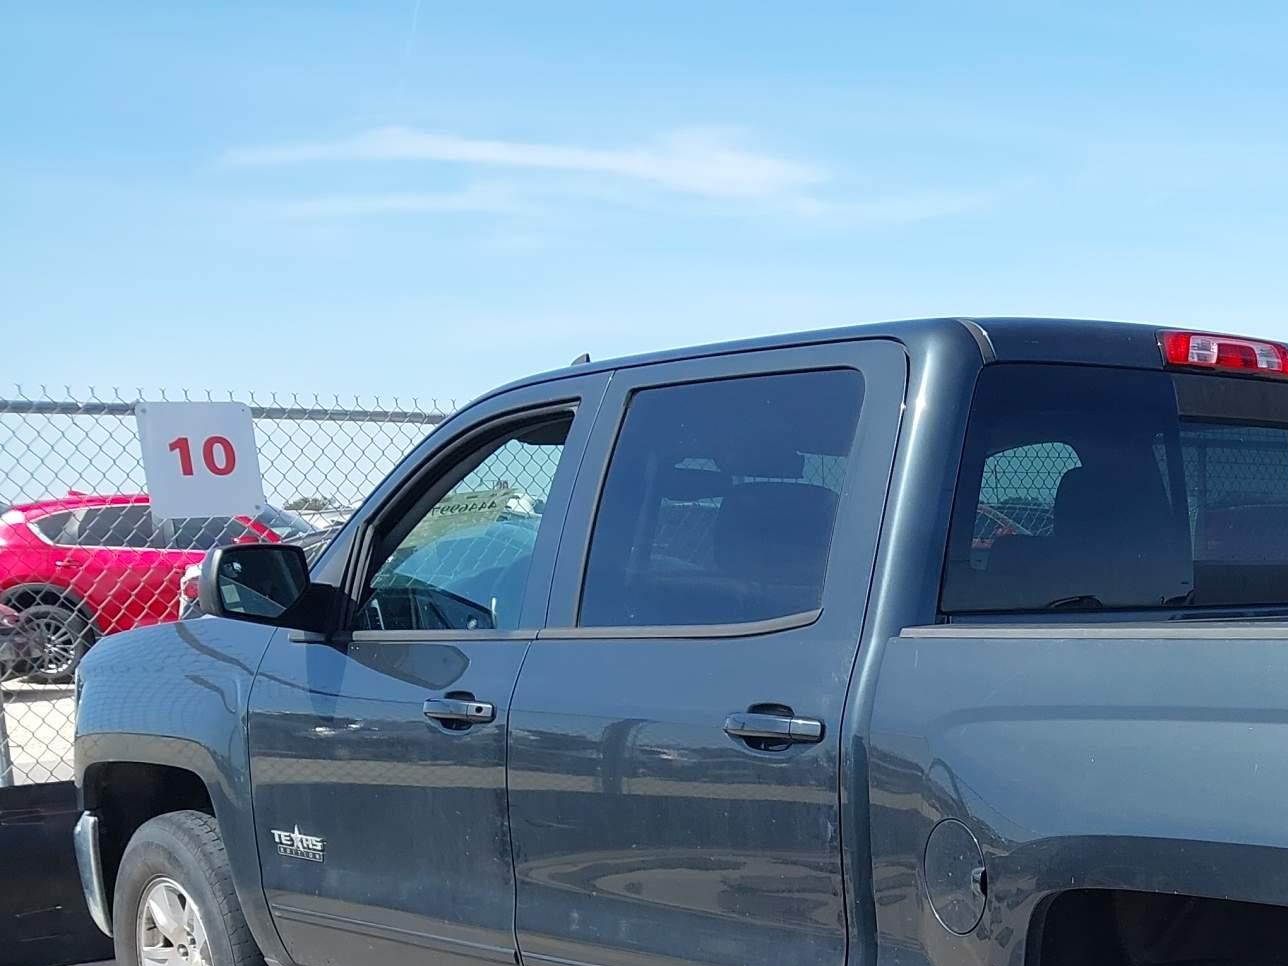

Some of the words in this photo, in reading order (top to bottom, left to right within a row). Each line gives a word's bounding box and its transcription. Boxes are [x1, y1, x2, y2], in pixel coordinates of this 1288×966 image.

[168, 435, 237, 477] 10
[270, 824, 323, 851] TEXAS
[279, 846, 320, 860] EDITION
